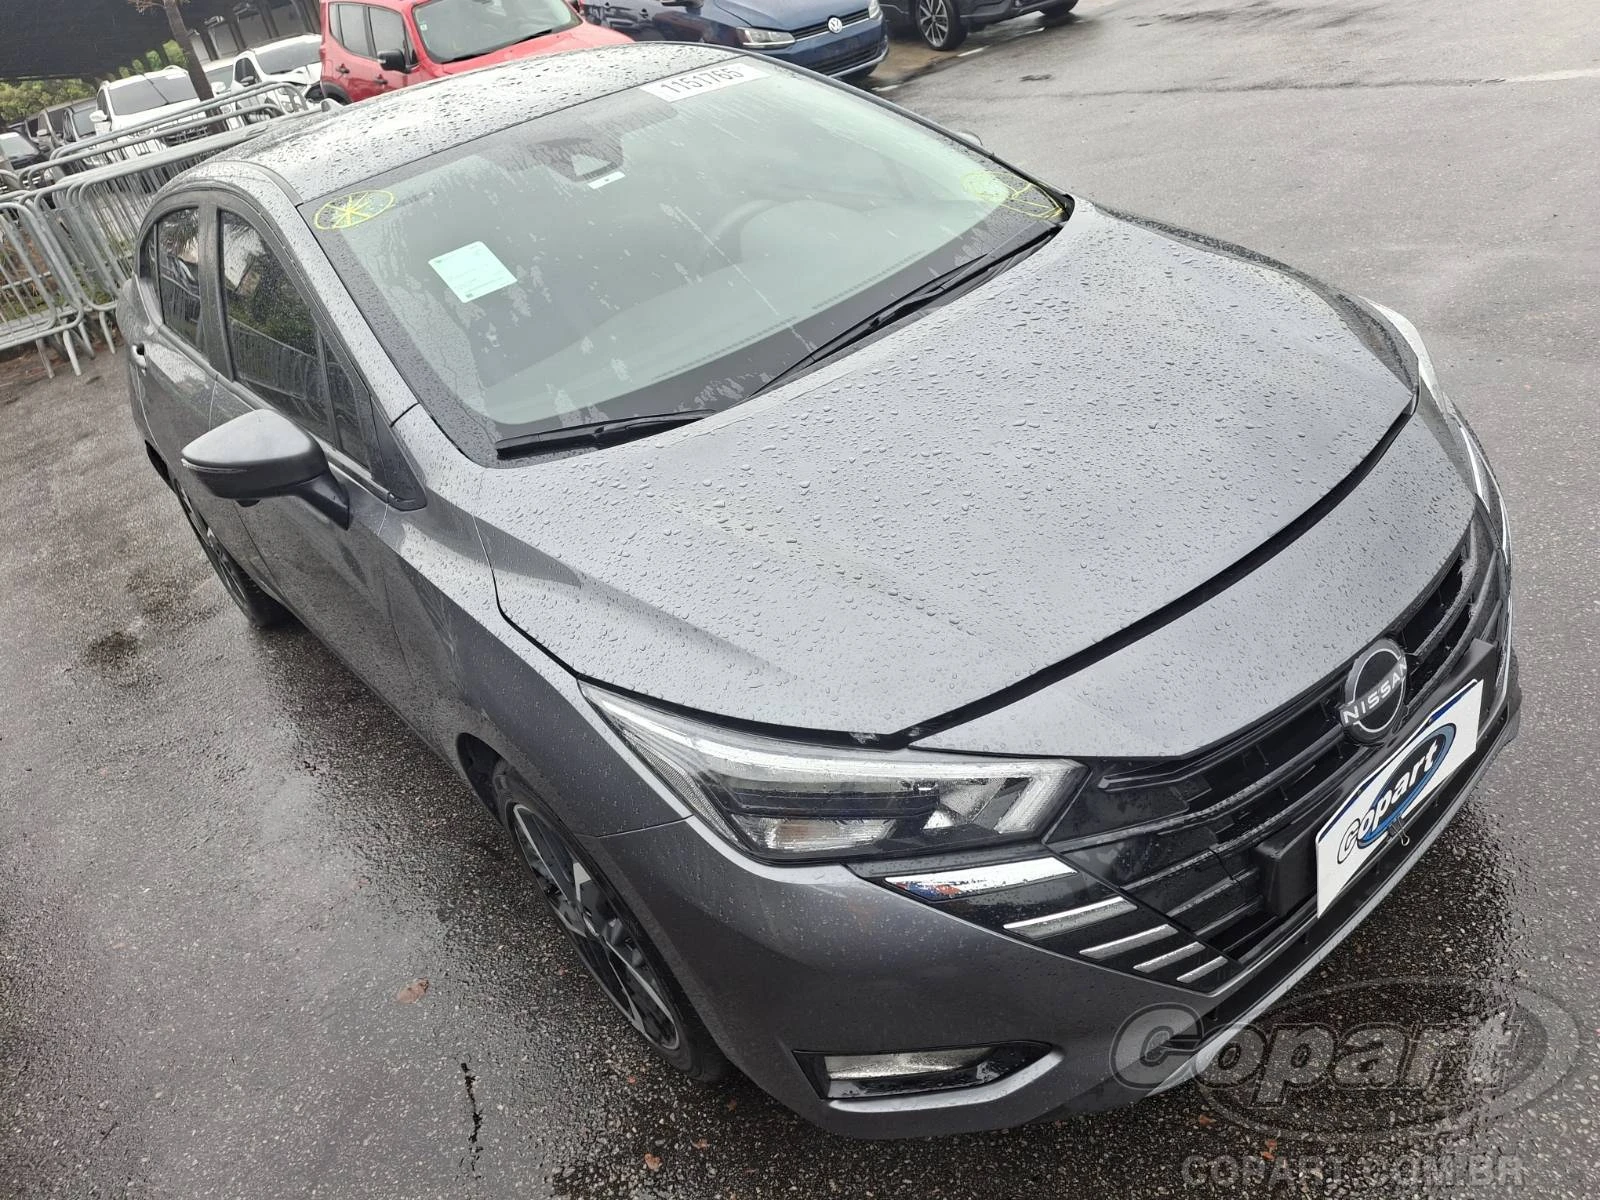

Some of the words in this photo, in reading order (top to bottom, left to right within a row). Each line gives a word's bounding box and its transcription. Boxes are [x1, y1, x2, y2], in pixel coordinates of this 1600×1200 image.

[661, 68, 744, 93] 1151765
[1342, 656, 1407, 724] NISSAN
[1337, 739, 1439, 864] Copart
